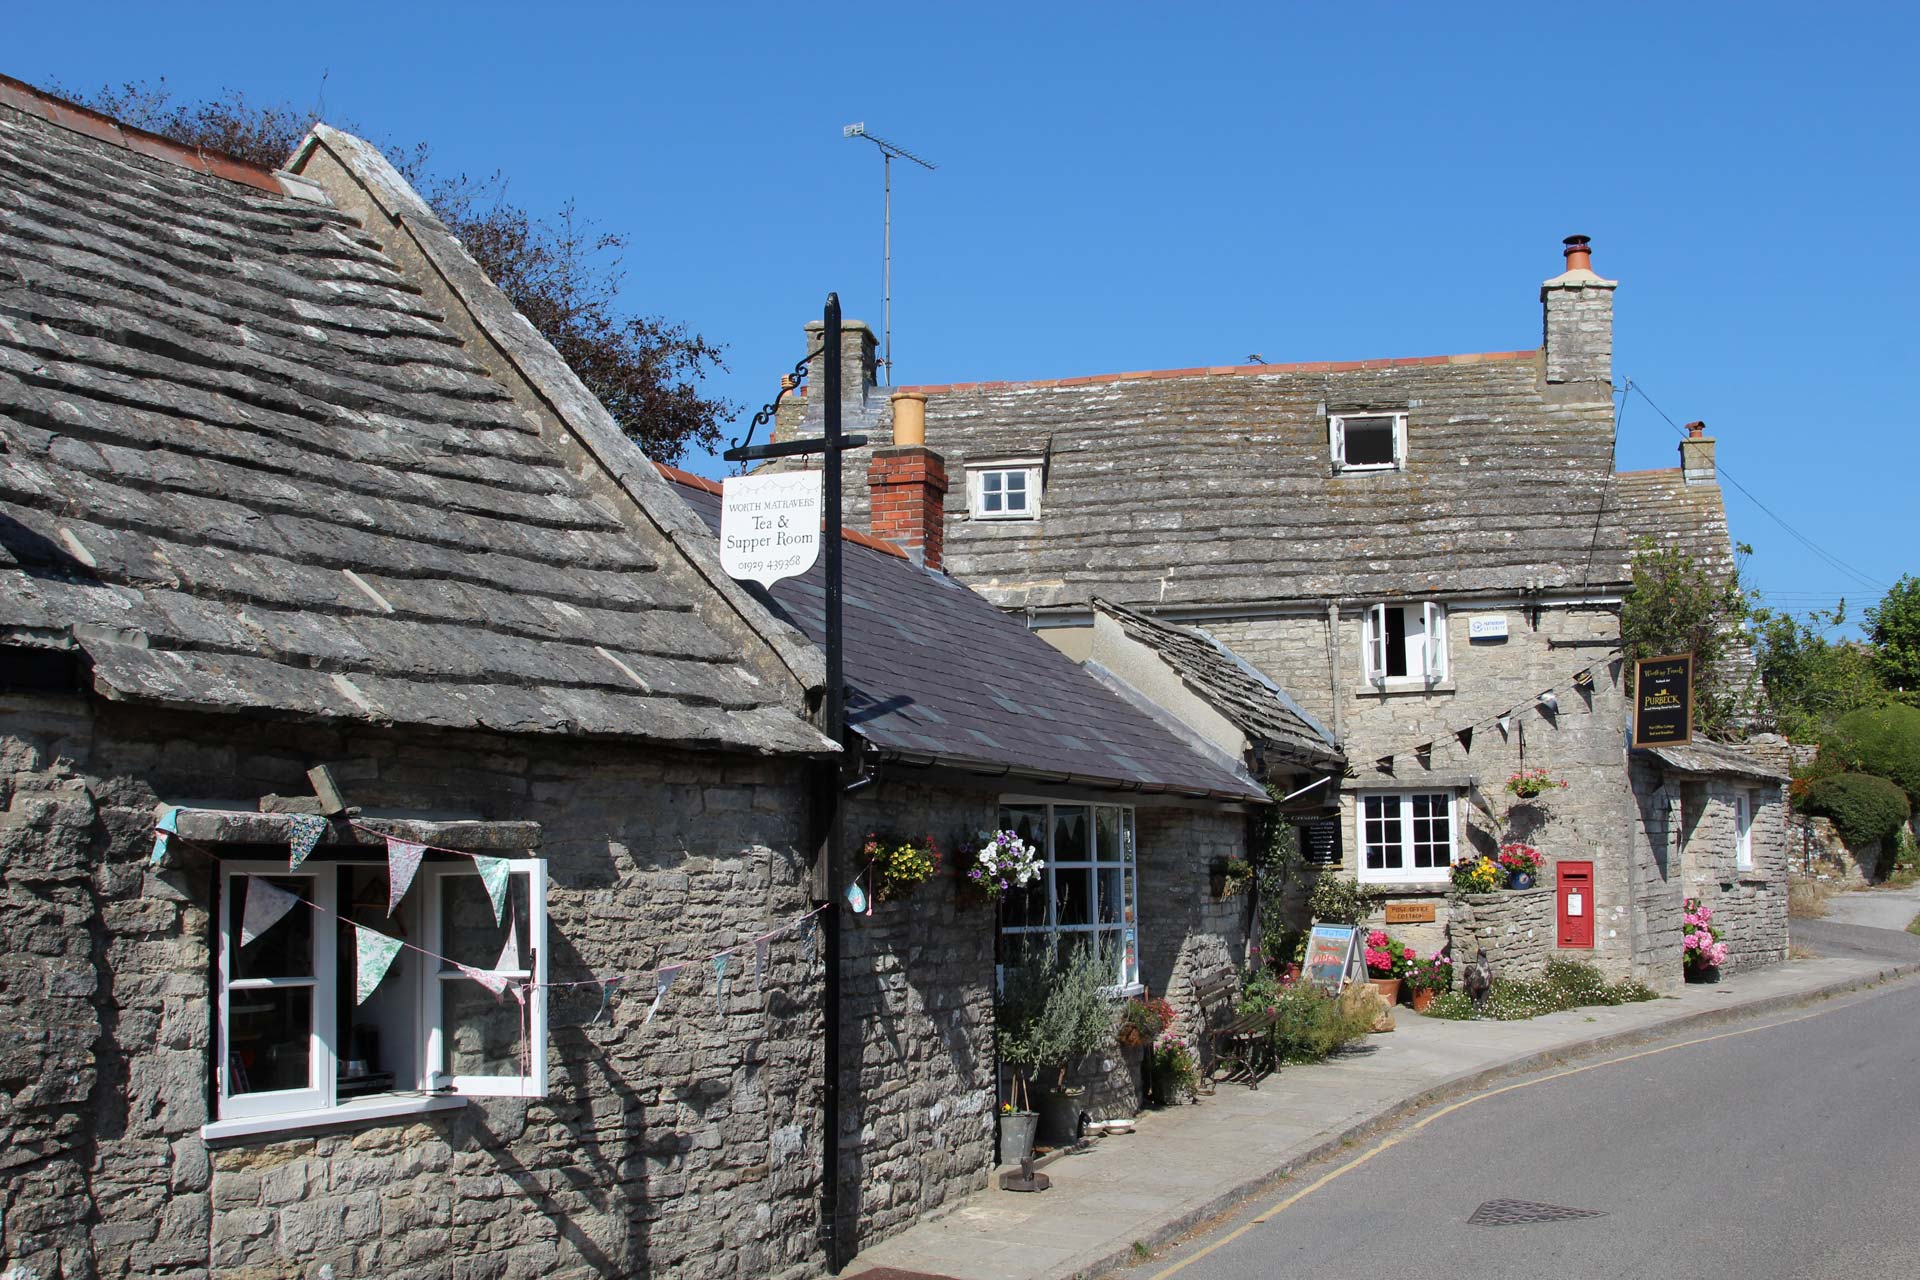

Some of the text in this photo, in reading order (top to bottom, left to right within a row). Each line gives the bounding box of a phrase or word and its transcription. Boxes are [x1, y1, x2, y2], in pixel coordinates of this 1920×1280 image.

[729, 498, 815, 513] WORTH MATRAVERS
[752, 514, 790, 530] Tea &
[727, 531, 813, 553] Supper Room
[738, 561, 763, 572] 01929
[1645, 695, 1680, 706] PURBECK
